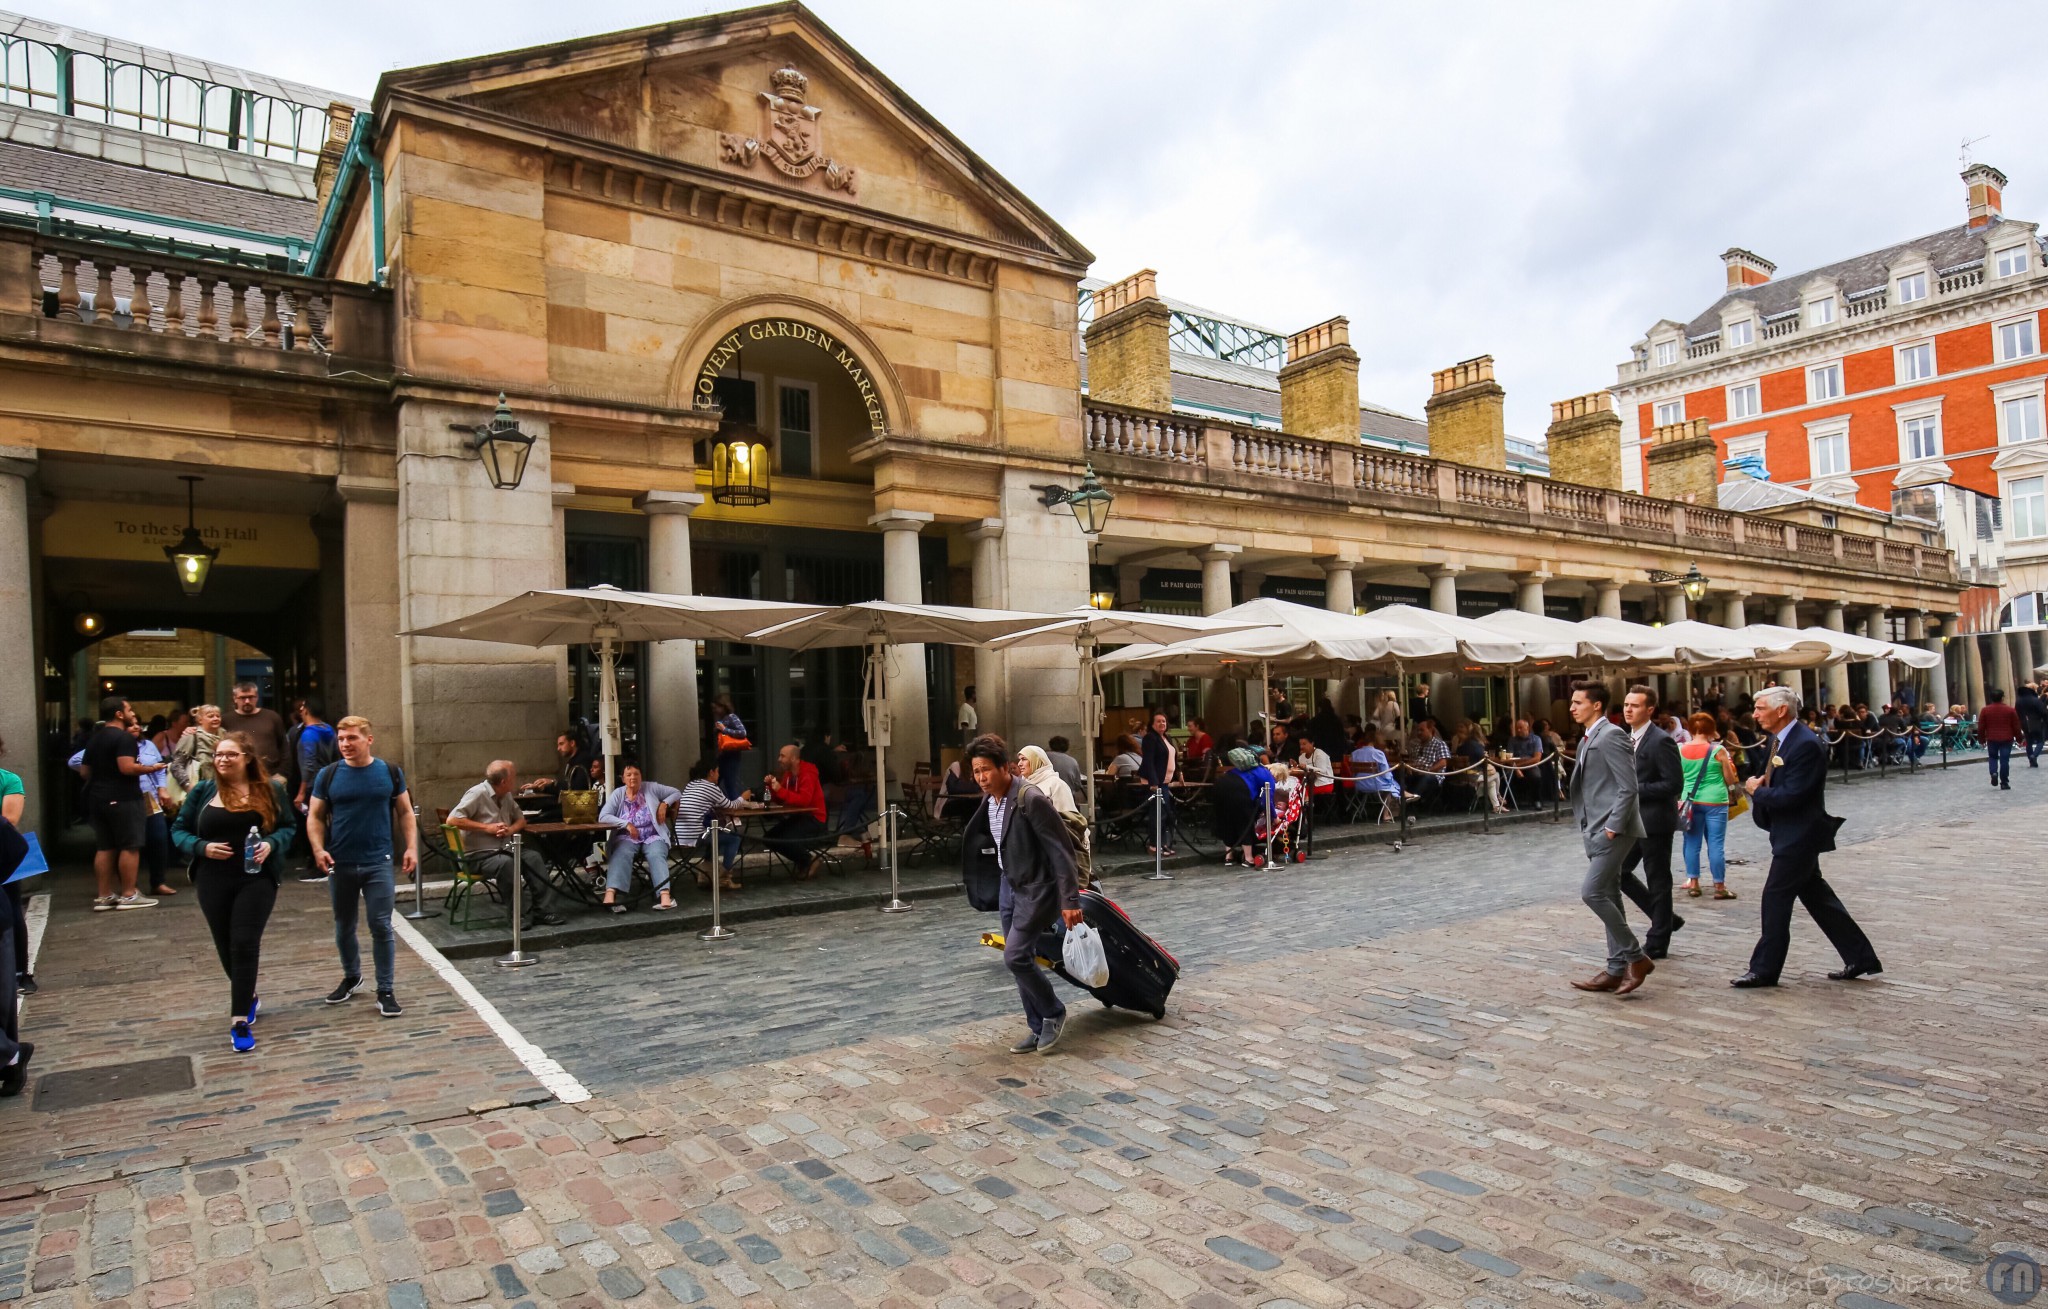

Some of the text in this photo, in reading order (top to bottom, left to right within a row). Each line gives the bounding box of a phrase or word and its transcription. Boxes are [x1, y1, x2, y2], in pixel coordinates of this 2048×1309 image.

[696, 321, 885, 434] COVENT GARDEN MARKET
[113, 520, 258, 541] To the Sth Hall
